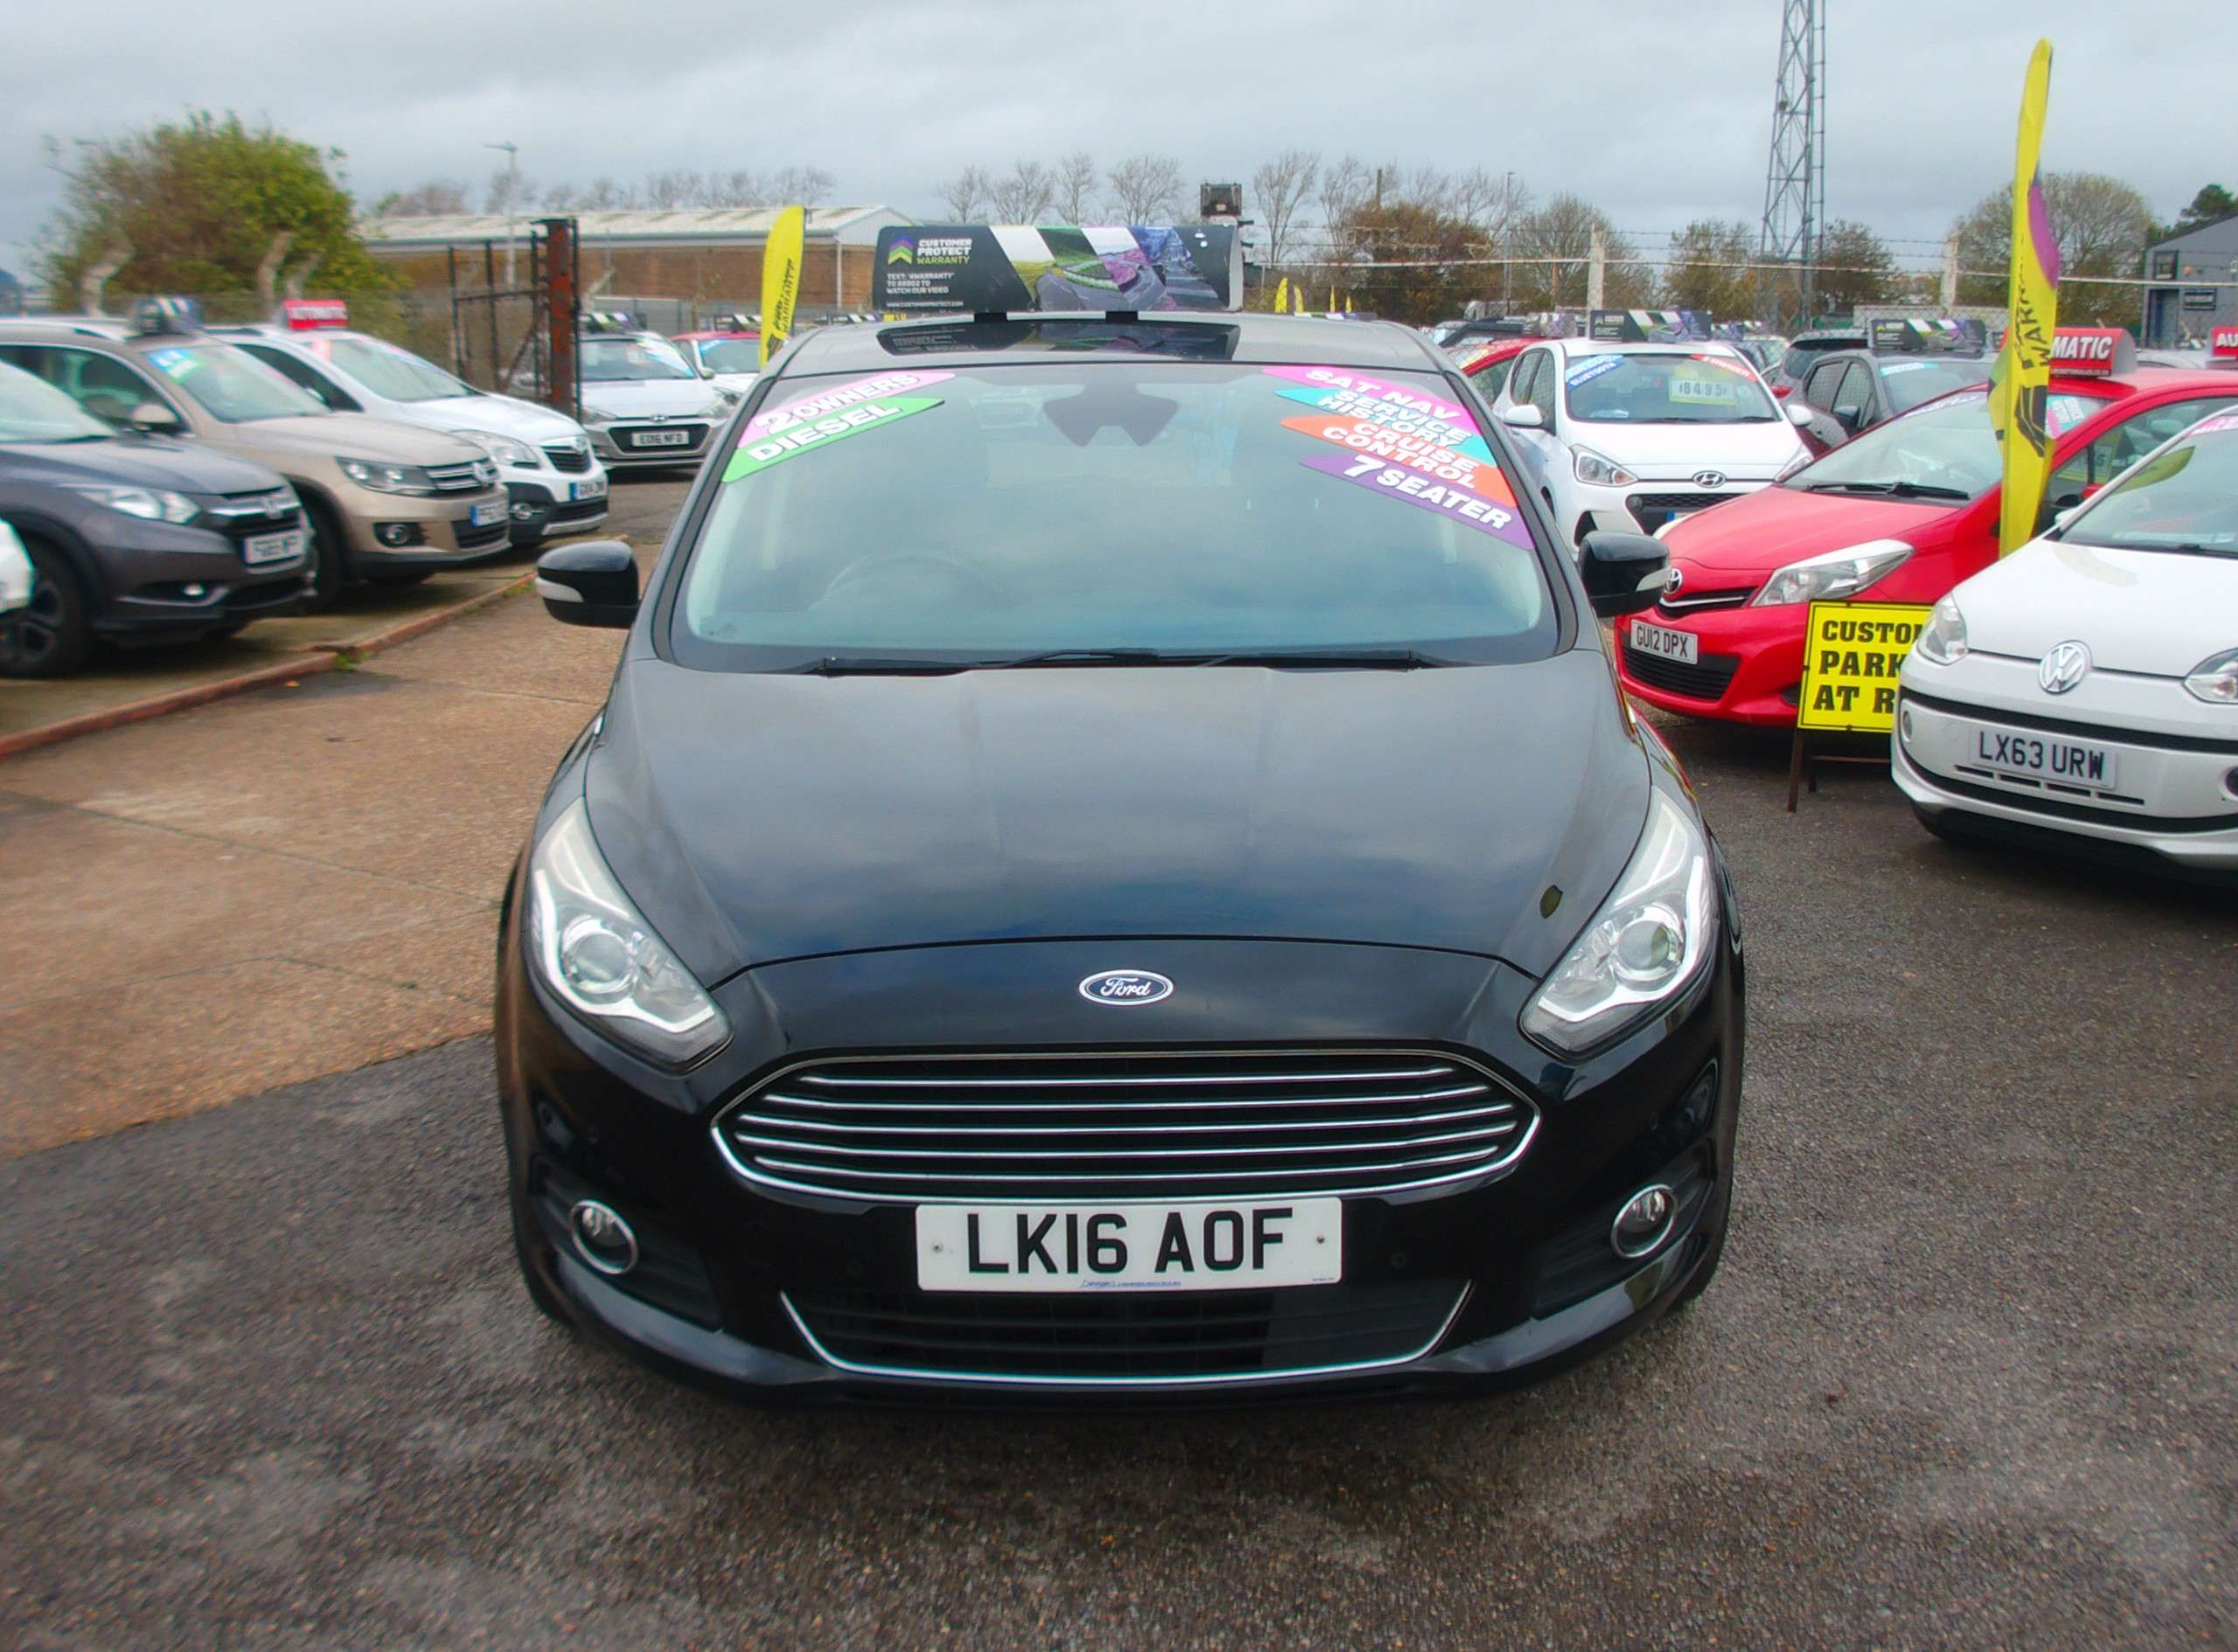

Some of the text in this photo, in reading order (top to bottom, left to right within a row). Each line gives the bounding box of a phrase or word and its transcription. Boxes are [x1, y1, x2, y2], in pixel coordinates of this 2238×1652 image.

[917, 247, 971, 256] PROTECT
[919, 239, 972, 247] CUSTOMER
[1305, 370, 1460, 420] SAT NAV
[1333, 390, 1472, 443] SERVICE
[747, 405, 900, 462] DIESEL
[1317, 397, 1461, 448] HISTORY
[1353, 422, 1479, 473] CRUISE
[1322, 427, 1476, 489] CONTROL
[1344, 455, 1512, 530] 7 SEATER
[1637, 626, 1688, 657] GU12 DPX
[1812, 684, 1859, 711] AT
[1979, 731, 2104, 781] LX63 URW
[1100, 977, 1151, 996] Ford
[967, 1207, 1293, 1274] LK16 AOF
